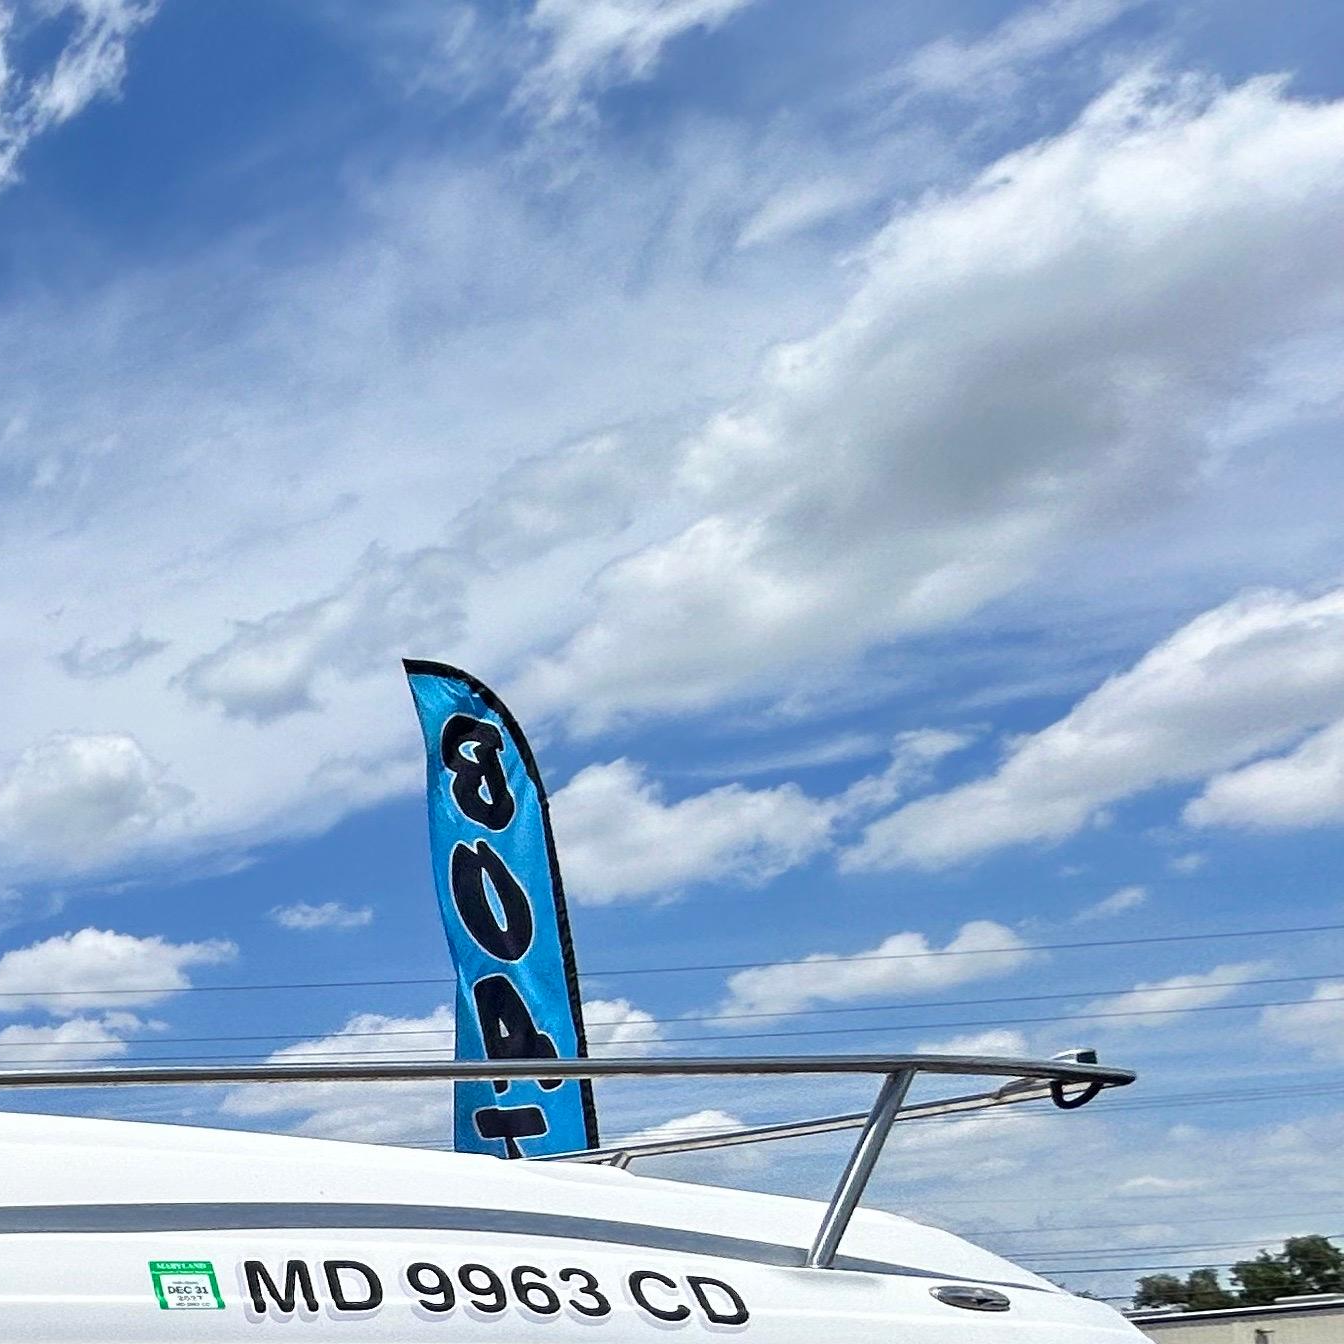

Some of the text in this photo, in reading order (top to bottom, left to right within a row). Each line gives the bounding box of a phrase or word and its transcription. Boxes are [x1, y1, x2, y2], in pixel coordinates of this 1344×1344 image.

[167, 1285, 209, 1295] DEC 31
[243, 1259, 750, 1326] MD 9963 CD
